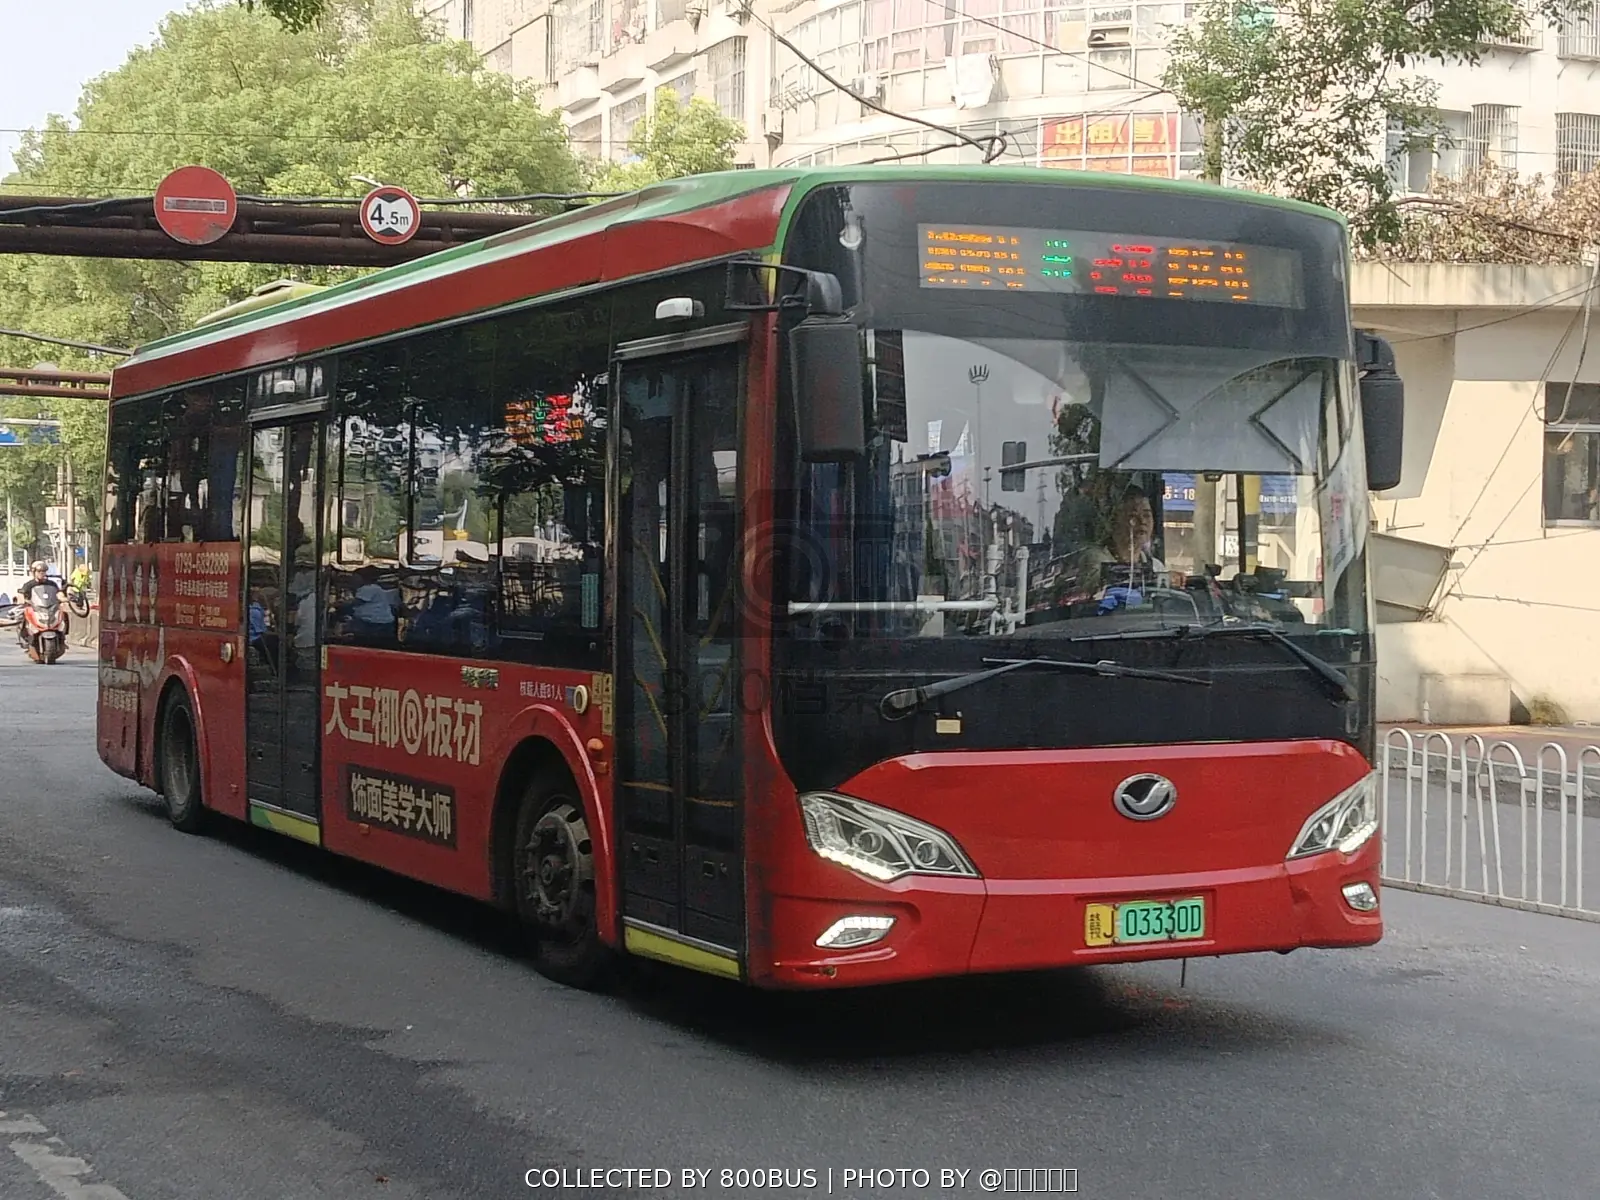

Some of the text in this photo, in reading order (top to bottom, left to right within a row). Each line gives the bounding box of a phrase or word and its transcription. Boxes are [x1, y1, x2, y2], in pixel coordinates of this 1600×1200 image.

[370, 203, 409, 226] 4.5m
[350, 772, 452, 840] 饰面美学大师
